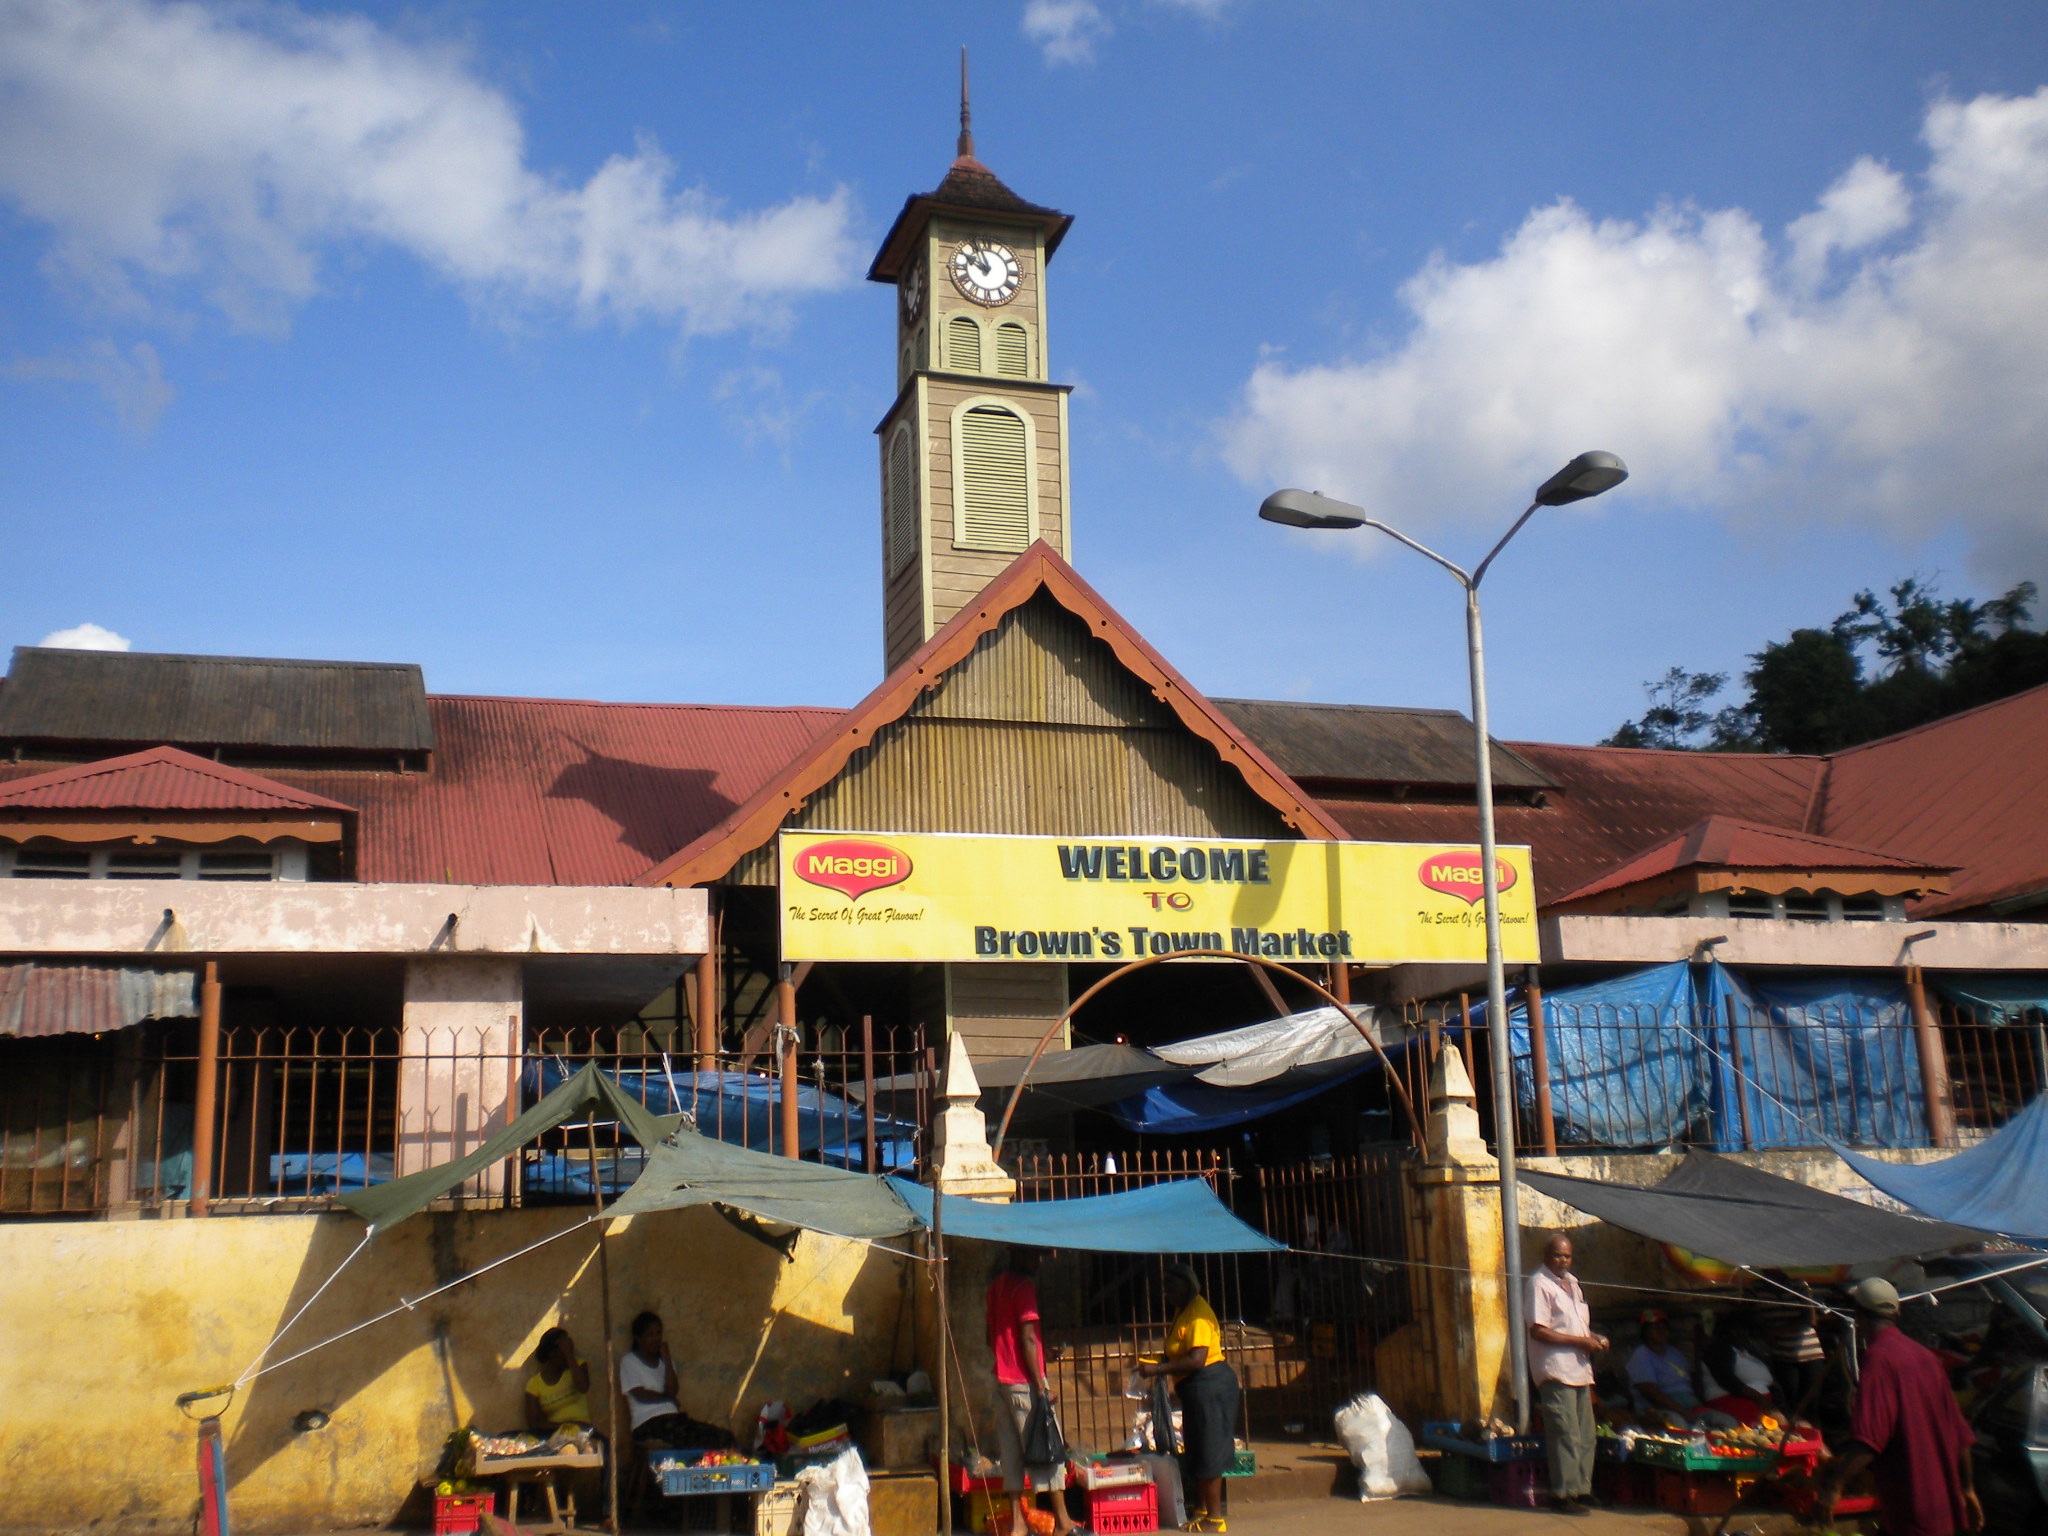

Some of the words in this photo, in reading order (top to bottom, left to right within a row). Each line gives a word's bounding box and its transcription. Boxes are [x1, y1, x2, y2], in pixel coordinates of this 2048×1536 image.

[808, 855, 898, 877] Maggi
[1057, 844, 1270, 883] WELCOME
[1431, 865, 1505, 884] Magi
[1143, 891, 1192, 910] TO
[788, 906, 805, 921] The
[808, 907, 838, 921] Secret
[841, 907, 853, 925] Of
[856, 907, 882, 925] Great
[884, 907, 925, 923] Flavour!
[1418, 911, 1432, 924] The
[1435, 912, 1459, 924] Secret
[1461, 912, 1472, 928] Of
[974, 926, 1122, 955] Brown's
[1128, 927, 1222, 955] Town
[1231, 928, 1352, 956] Market
